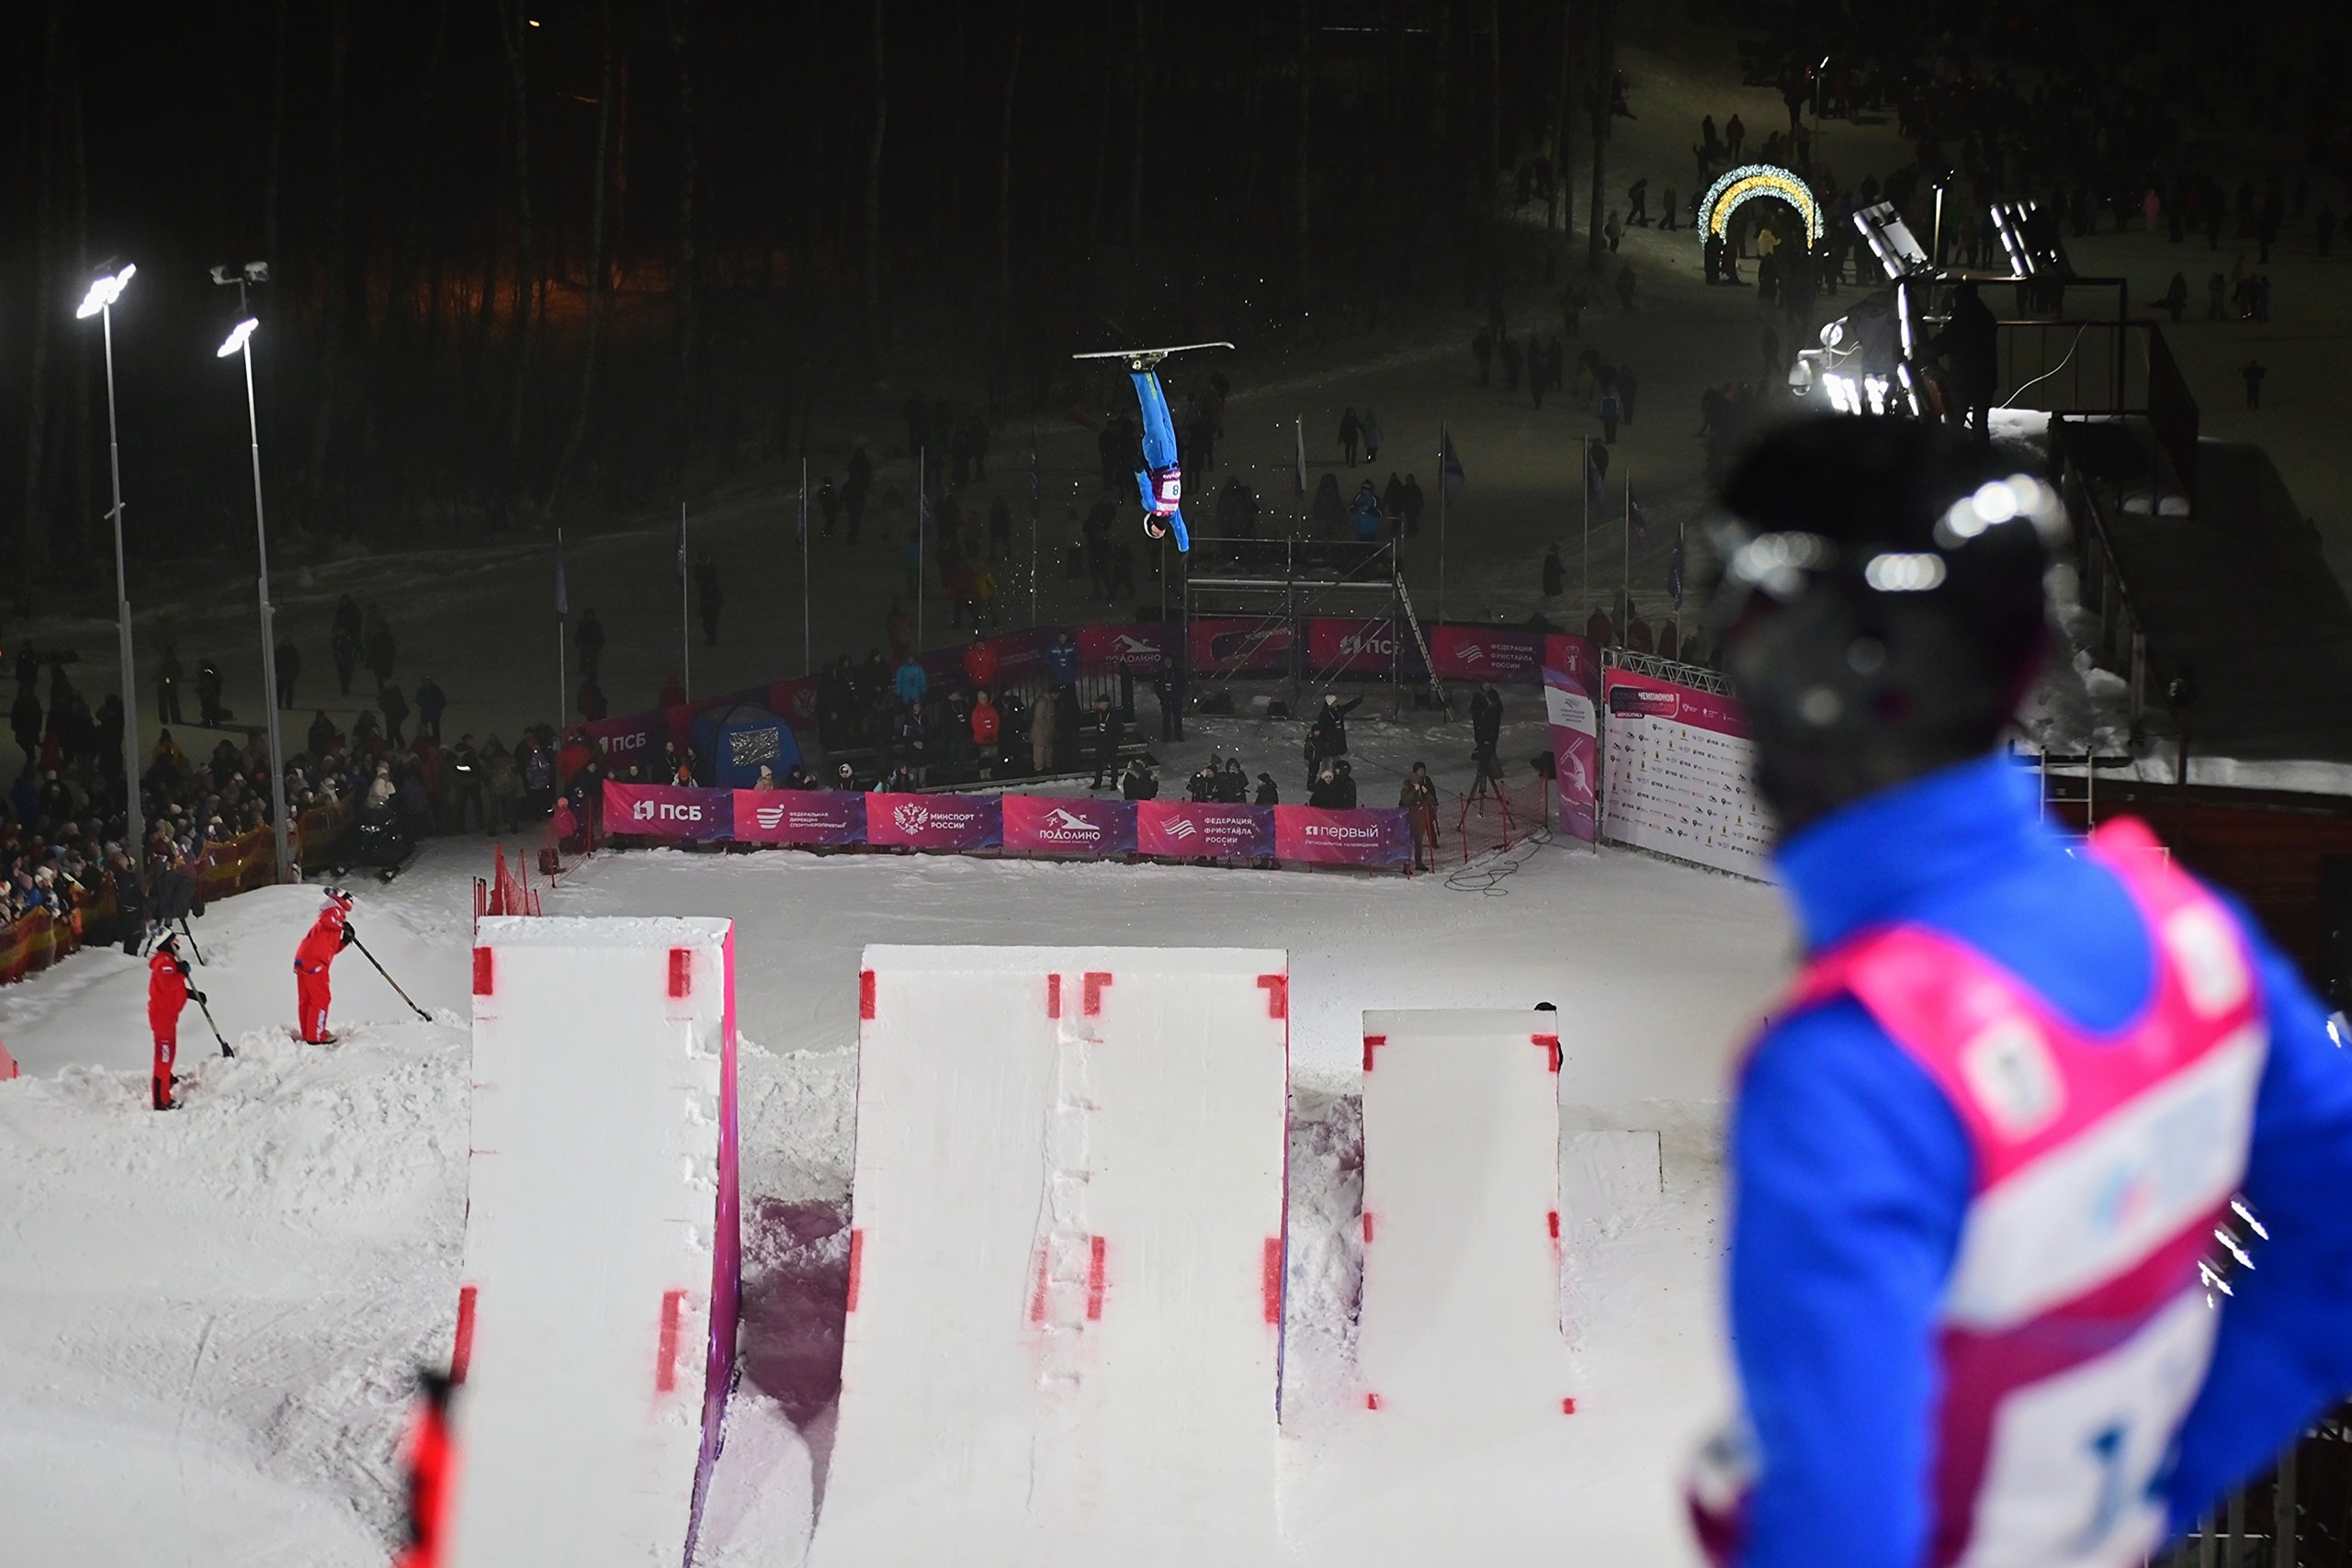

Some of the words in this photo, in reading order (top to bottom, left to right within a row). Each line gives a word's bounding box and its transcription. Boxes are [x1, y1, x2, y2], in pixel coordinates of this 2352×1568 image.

[1491, 661, 1521, 670] РОССИИ
[613, 732, 646, 752] ПСБ
[660, 804, 702, 821] ПСБ
[930, 813, 974, 821] МИНСПОРТ
[1204, 818, 1252, 826] ФЕДЕРАЦИЯ
[1039, 829, 1101, 840] ПОДОЛИНО
[1204, 827, 1252, 836] ФРИСТАЙЛА
